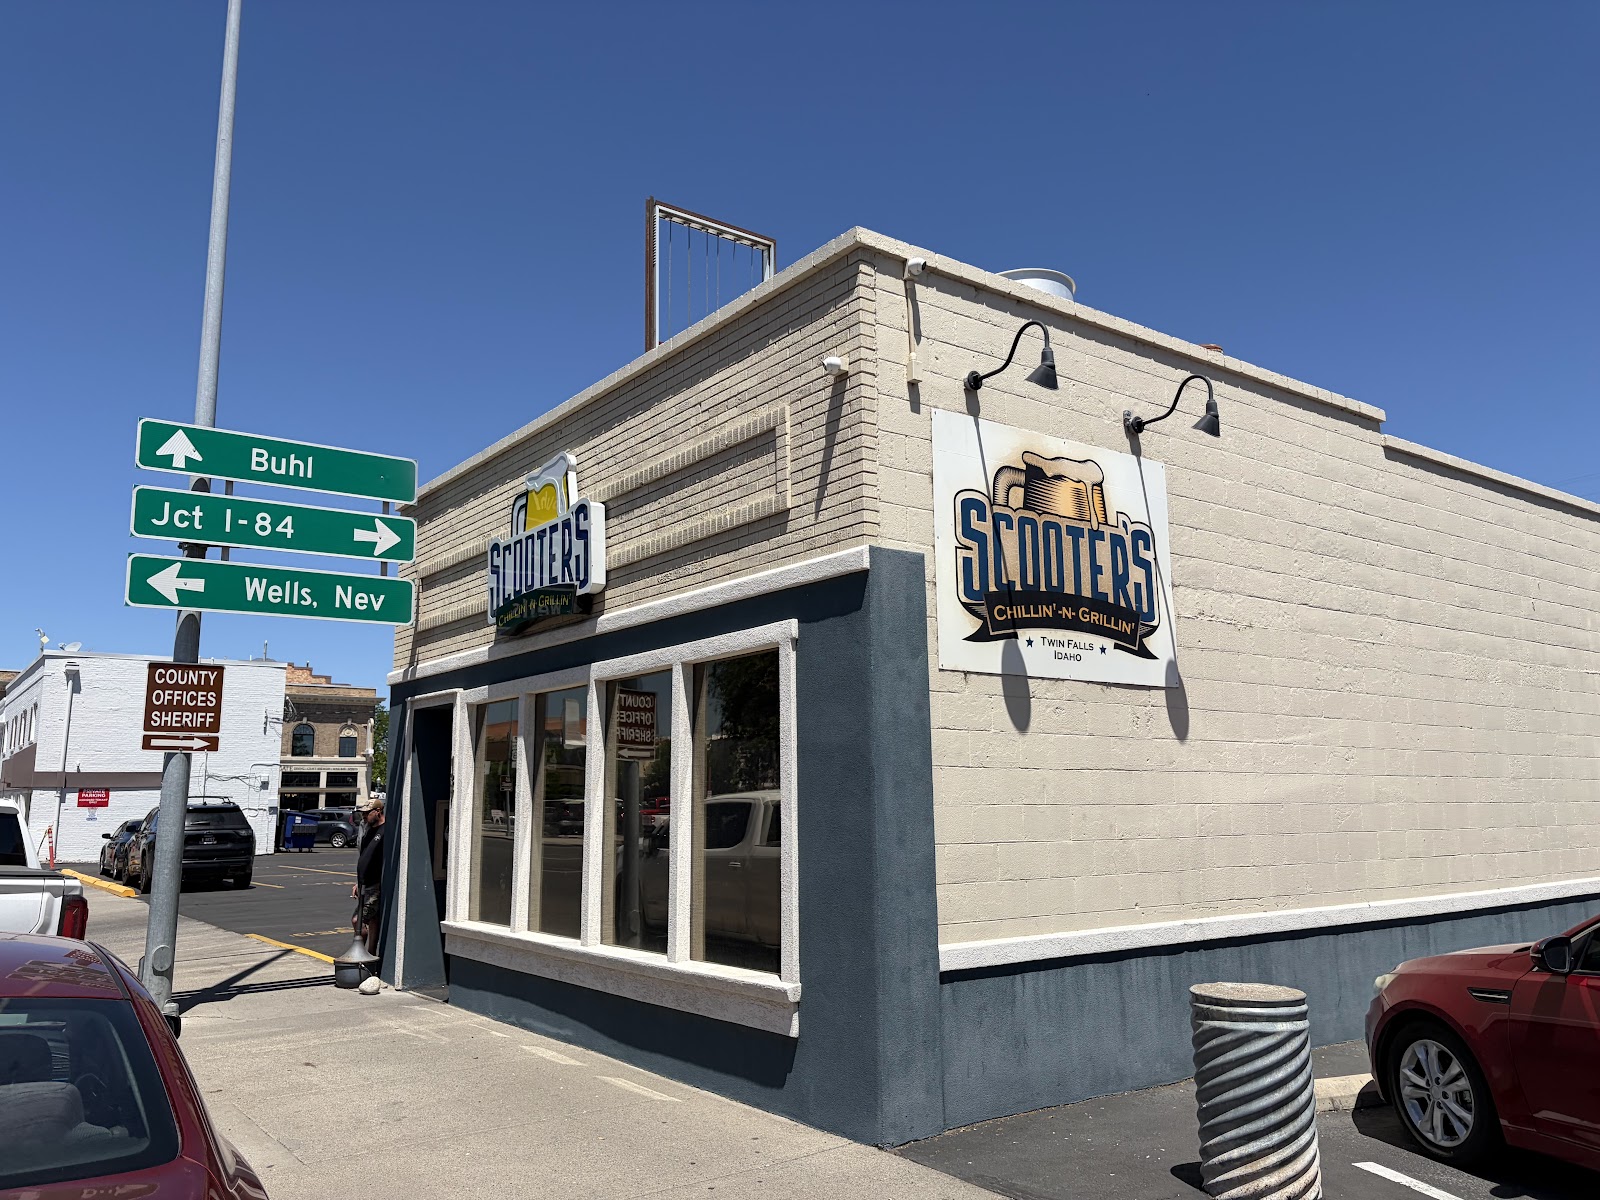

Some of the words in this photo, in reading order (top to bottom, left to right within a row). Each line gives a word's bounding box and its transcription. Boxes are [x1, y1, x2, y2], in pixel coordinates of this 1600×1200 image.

[251, 448, 313, 478] Buhl
[151, 501, 203, 530] Jct
[225, 508, 294, 539] I-84
[490, 502, 589, 618] SCOOTER'S
[960, 497, 1155, 622] SCOOTER'S
[245, 576, 318, 608] Wells,
[335, 584, 385, 611] Nev
[538, 593, 571, 607] GRILLIN'
[993, 603, 1056, 621] CHILLIN'
[1078, 607, 1136, 635] GRILLIN'
[1040, 636, 1065, 648] TWIN
[1067, 639, 1095, 651] FALLS
[1054, 650, 1082, 662] IDAHO
[155, 668, 217, 686] COUNTY
[152, 689, 217, 707] OFFICES
[150, 710, 215, 728] SHERIFF
